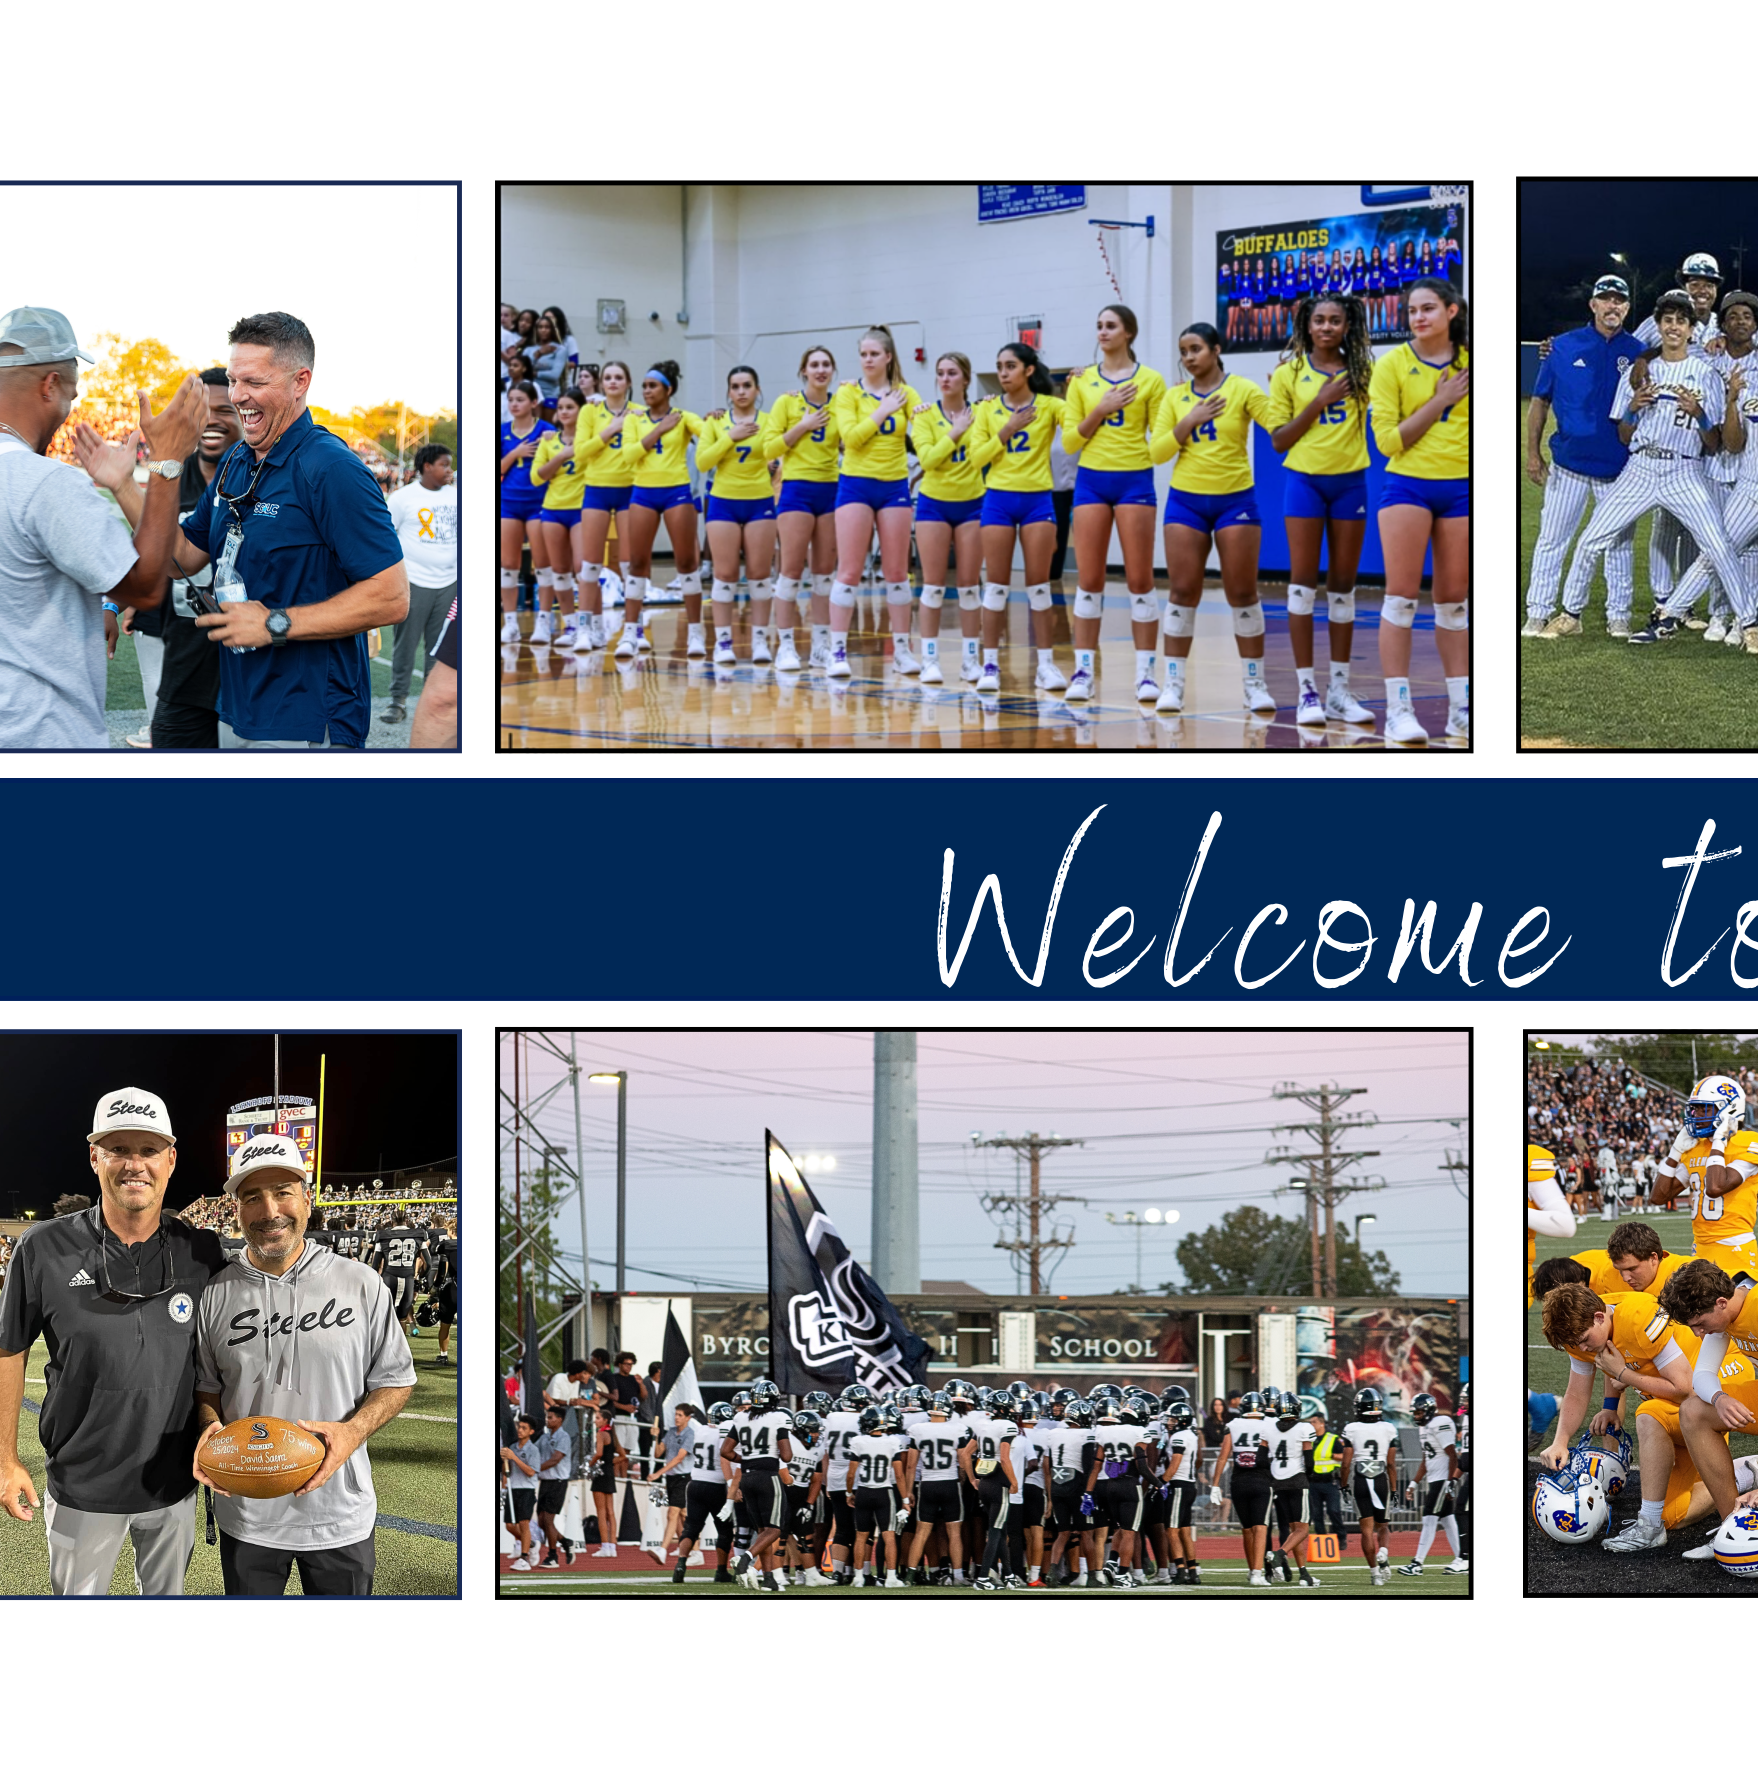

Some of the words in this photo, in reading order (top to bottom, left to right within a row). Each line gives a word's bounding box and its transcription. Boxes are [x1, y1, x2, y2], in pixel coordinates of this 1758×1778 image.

[1234, 229, 1329, 256] BUFFALOES
[1319, 401, 1346, 424] 15
[1674, 409, 1694, 430] 21
[609, 433, 622, 449] 3
[811, 426, 826, 442] 9
[1006, 431, 1030, 453] 12
[1191, 420, 1217, 443] 14
[736, 446, 752, 463] 7
[562, 461, 576, 475] 2
[107, 1099, 157, 1119] Steele
[274, 1095, 314, 1106] TADIUM
[280, 1107, 305, 1120] gvec
[240, 1144, 286, 1167] Steele
[388, 1238, 415, 1267] 28
[69, 1279, 95, 1287] adidas
[227, 1298, 355, 1347] Steele
[1050, 1335, 1159, 1358] SCHOOL
[207, 1435, 236, 1448] October
[280, 1428, 296, 1444] 75
[297, 1438, 317, 1455] wins
[739, 1427, 770, 1457] 94
[1104, 1442, 1134, 1462] 22
[1364, 1439, 1379, 1461] 3
[240, 1451, 263, 1464] David
[693, 1443, 716, 1471] 51
[792, 1456, 816, 1467] STEELE
[920, 1438, 954, 1470] 35
[1275, 1440, 1287, 1468] 4
[245, 1462, 280, 1473] Winningest
[281, 1462, 299, 1470] Coach
[860, 1454, 889, 1483] 30
[1313, 1537, 1335, 1559] 10
